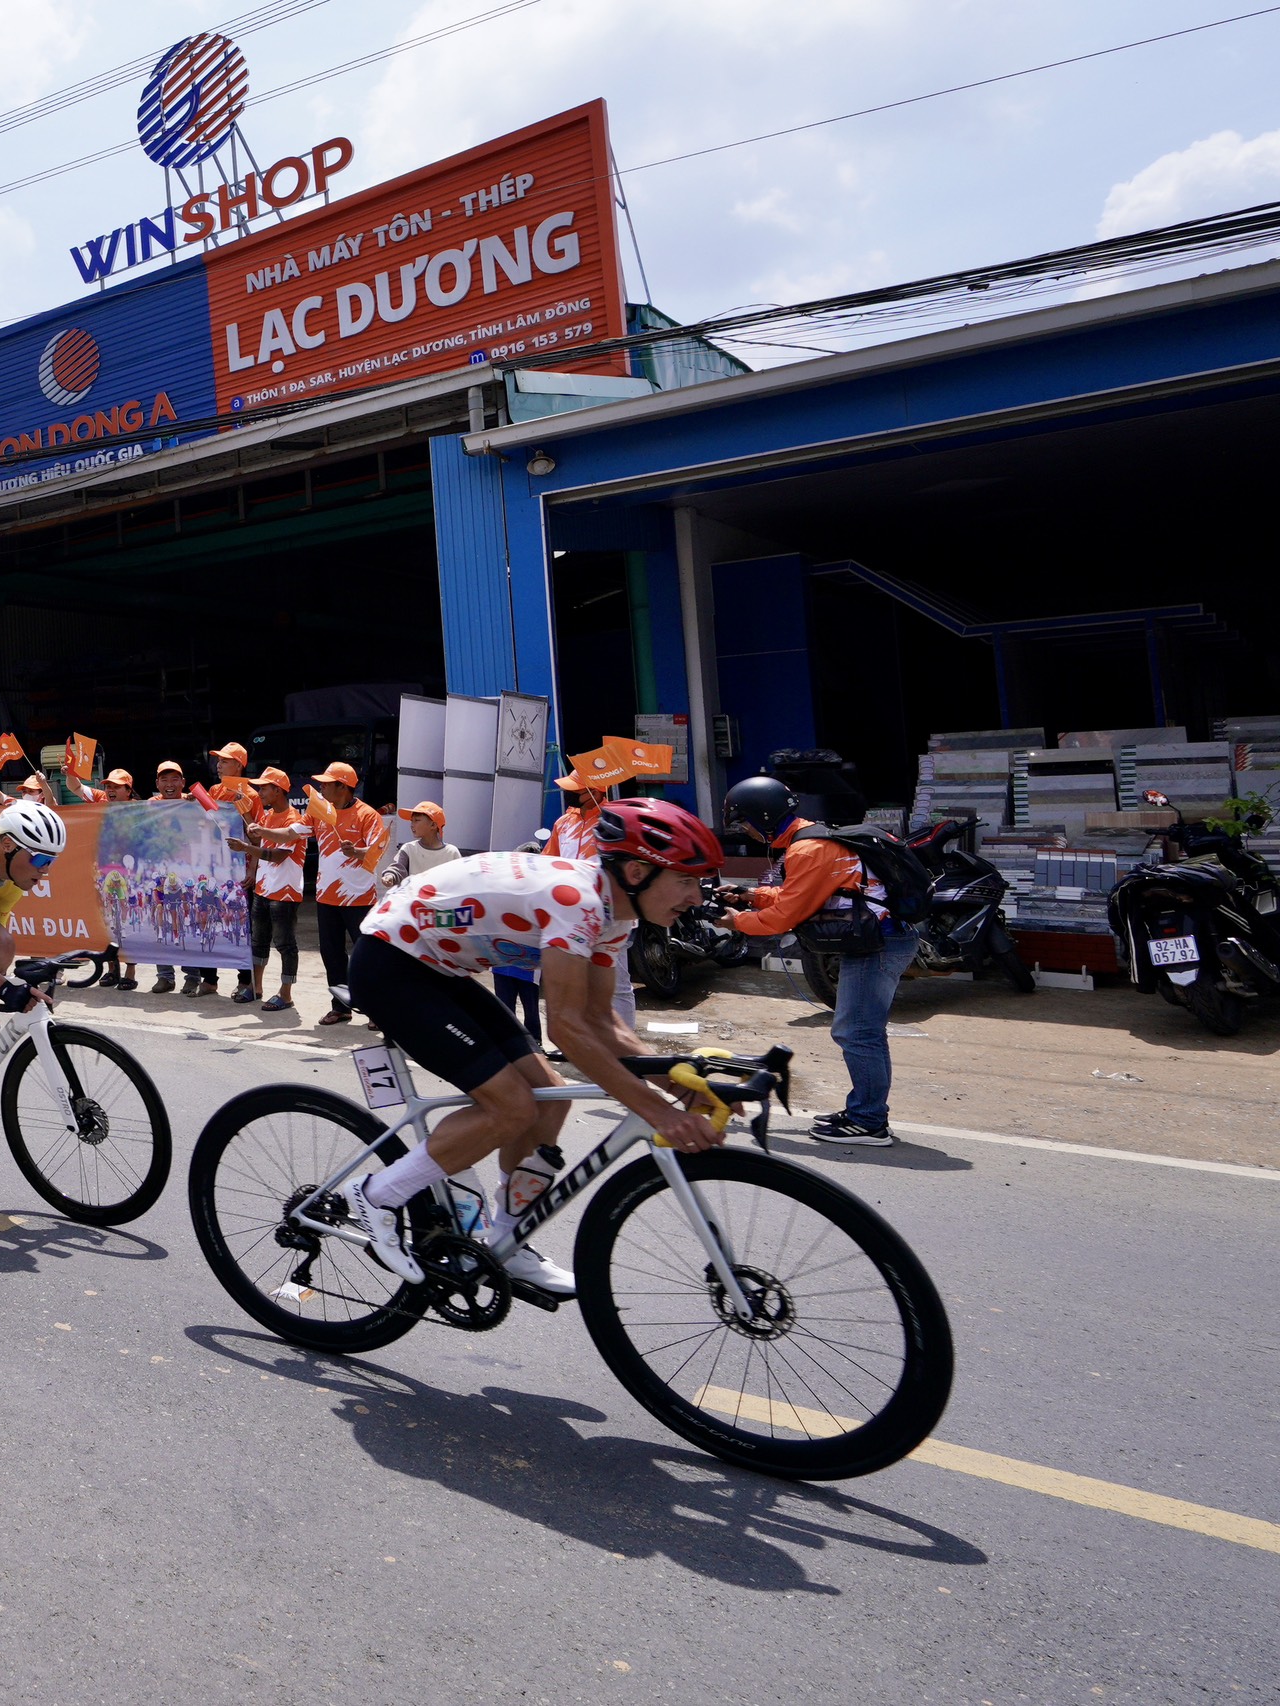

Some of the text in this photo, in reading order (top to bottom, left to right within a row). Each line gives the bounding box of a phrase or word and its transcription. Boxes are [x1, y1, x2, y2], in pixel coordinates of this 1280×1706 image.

[70, 137, 354, 284] WINSHOP
[246, 254, 301, 294] NHÀ
[308, 233, 364, 273] MÁY
[372, 208, 433, 248] TÔN
[459, 172, 535, 217] THÉP
[225, 211, 581, 374] LẠC DƯƠNG
[247, 388, 278, 404] THÔN
[281, 386, 287, 395] 1
[289, 381, 306, 392] ĐẠ
[309, 372, 336, 387] SAR,
[339, 358, 381, 379] HUYỆN
[384, 350, 408, 367] LẠC
[412, 334, 468, 357] DƯƠNG,
[469, 324, 503, 341] TỈNH
[507, 312, 541, 331] LÂM
[545, 297, 592, 320] ĐỒNG
[490, 340, 526, 359] 0916
[532, 332, 558, 348] 153
[564, 322, 593, 340] 579
[118, 444, 144, 461] GIA
[8, 910, 90, 938] ÀN ĐUA
[419, 906, 473, 929] HTV
[1154, 949, 1197, 963] 057.92
[1155, 938, 1189, 952] 92-HA
[366, 1063, 396, 1088] 17
[56, 1086, 72, 1117] OSTRO
[513, 1142, 614, 1244] GIANT
